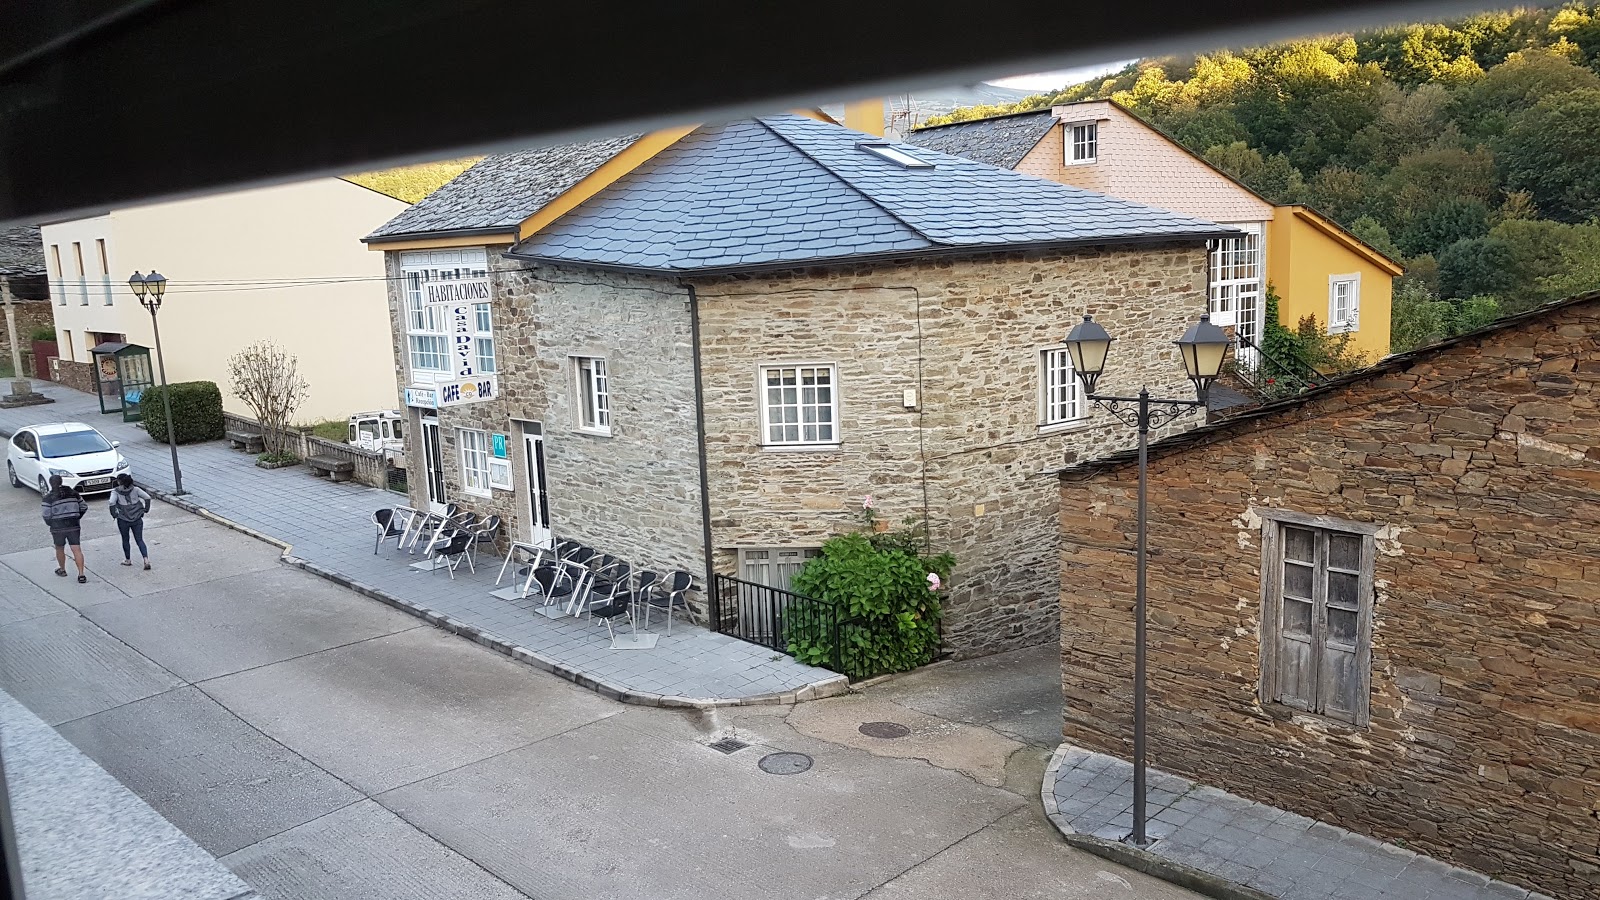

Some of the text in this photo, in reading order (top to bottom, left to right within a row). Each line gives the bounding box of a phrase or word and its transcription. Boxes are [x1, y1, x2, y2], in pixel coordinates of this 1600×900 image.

[428, 282, 489, 302] HABITACIONES
[454, 306, 472, 376] Casa David
[443, 381, 492, 402] CAFE BAR
